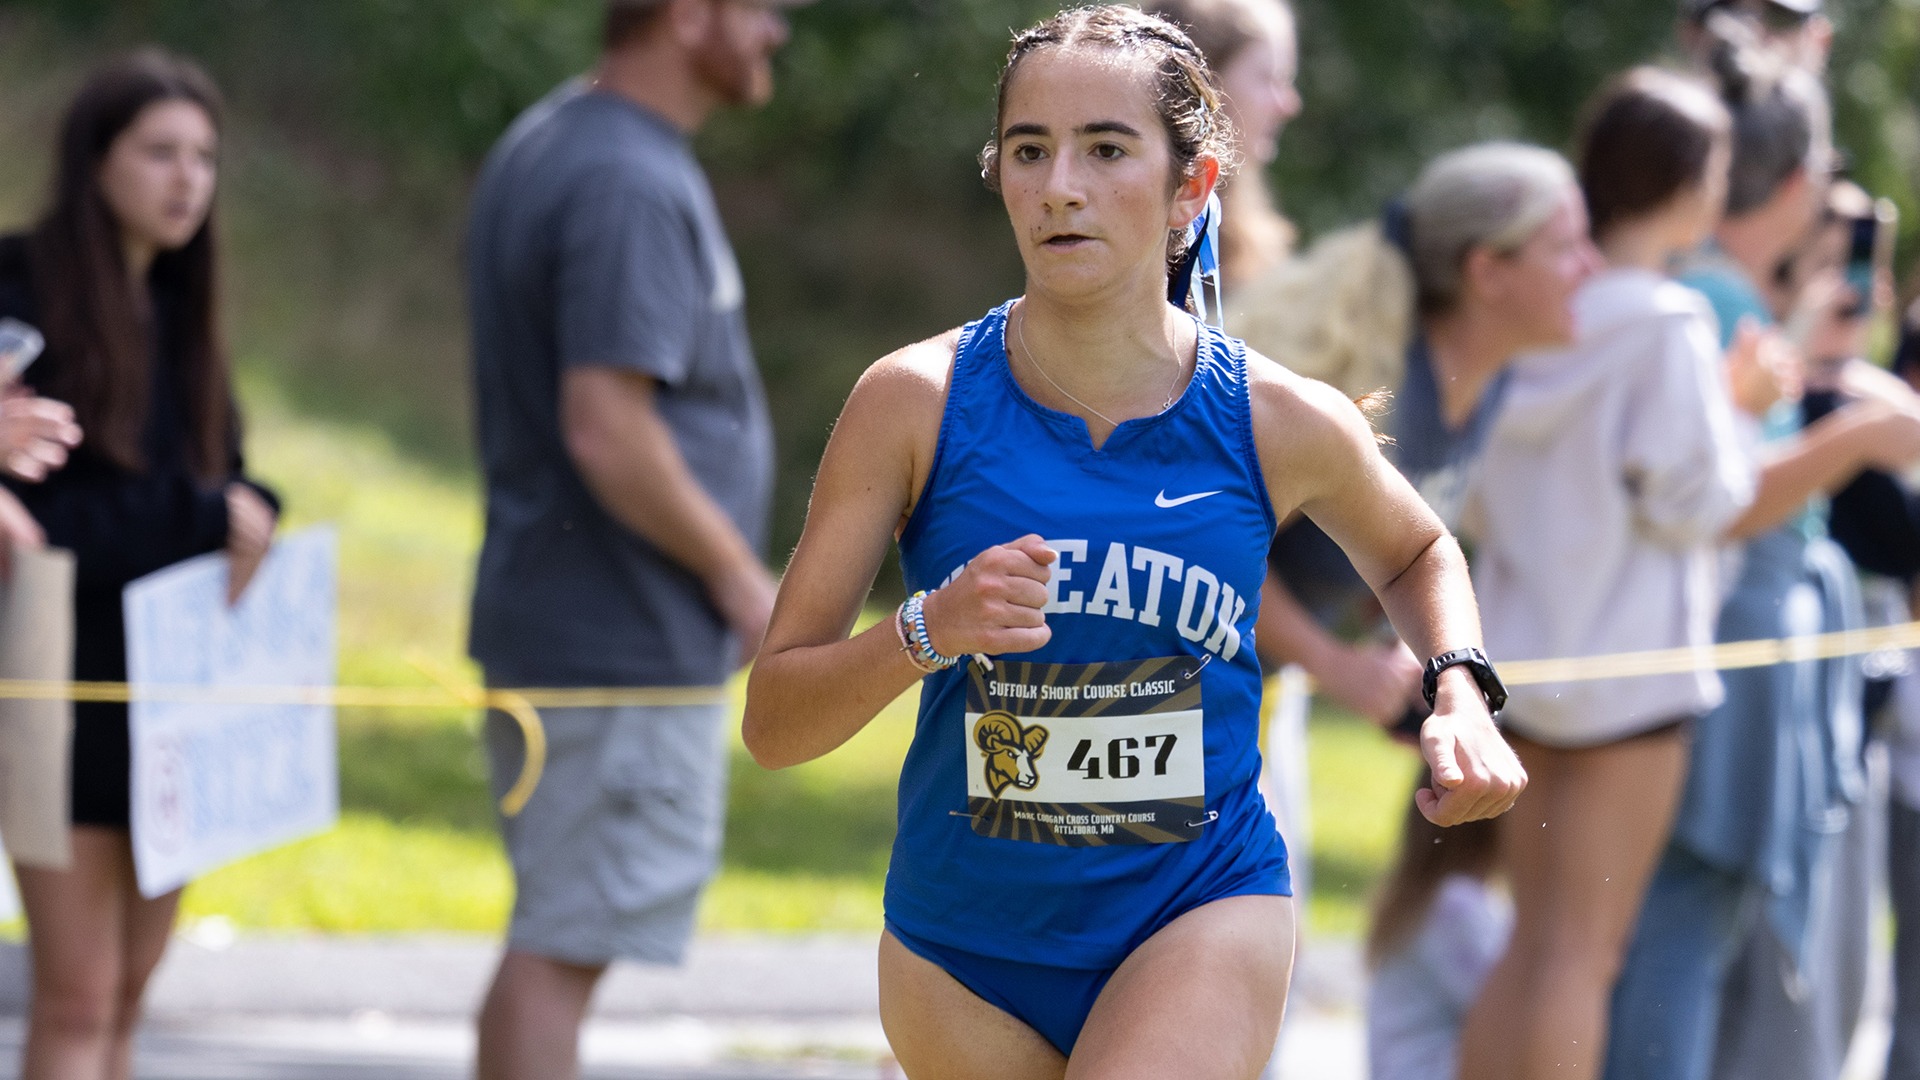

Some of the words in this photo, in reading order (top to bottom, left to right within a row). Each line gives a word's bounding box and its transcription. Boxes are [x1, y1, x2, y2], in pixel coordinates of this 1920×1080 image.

[940, 539, 1246, 662] EATON
[989, 680, 1038, 699] SUFFOLK
[1041, 684, 1079, 700] SHORT
[1083, 684, 1127, 699] COURSE
[1130, 680, 1175, 697] CLASSIC
[1066, 733, 1178, 780] 467
[1013, 811, 1036, 821] MARC
[1066, 814, 1089, 825] CROSS
[1091, 814, 1126, 825] COUNTRY
[1128, 812, 1156, 823] COURSE
[1100, 824, 1115, 834] MA
